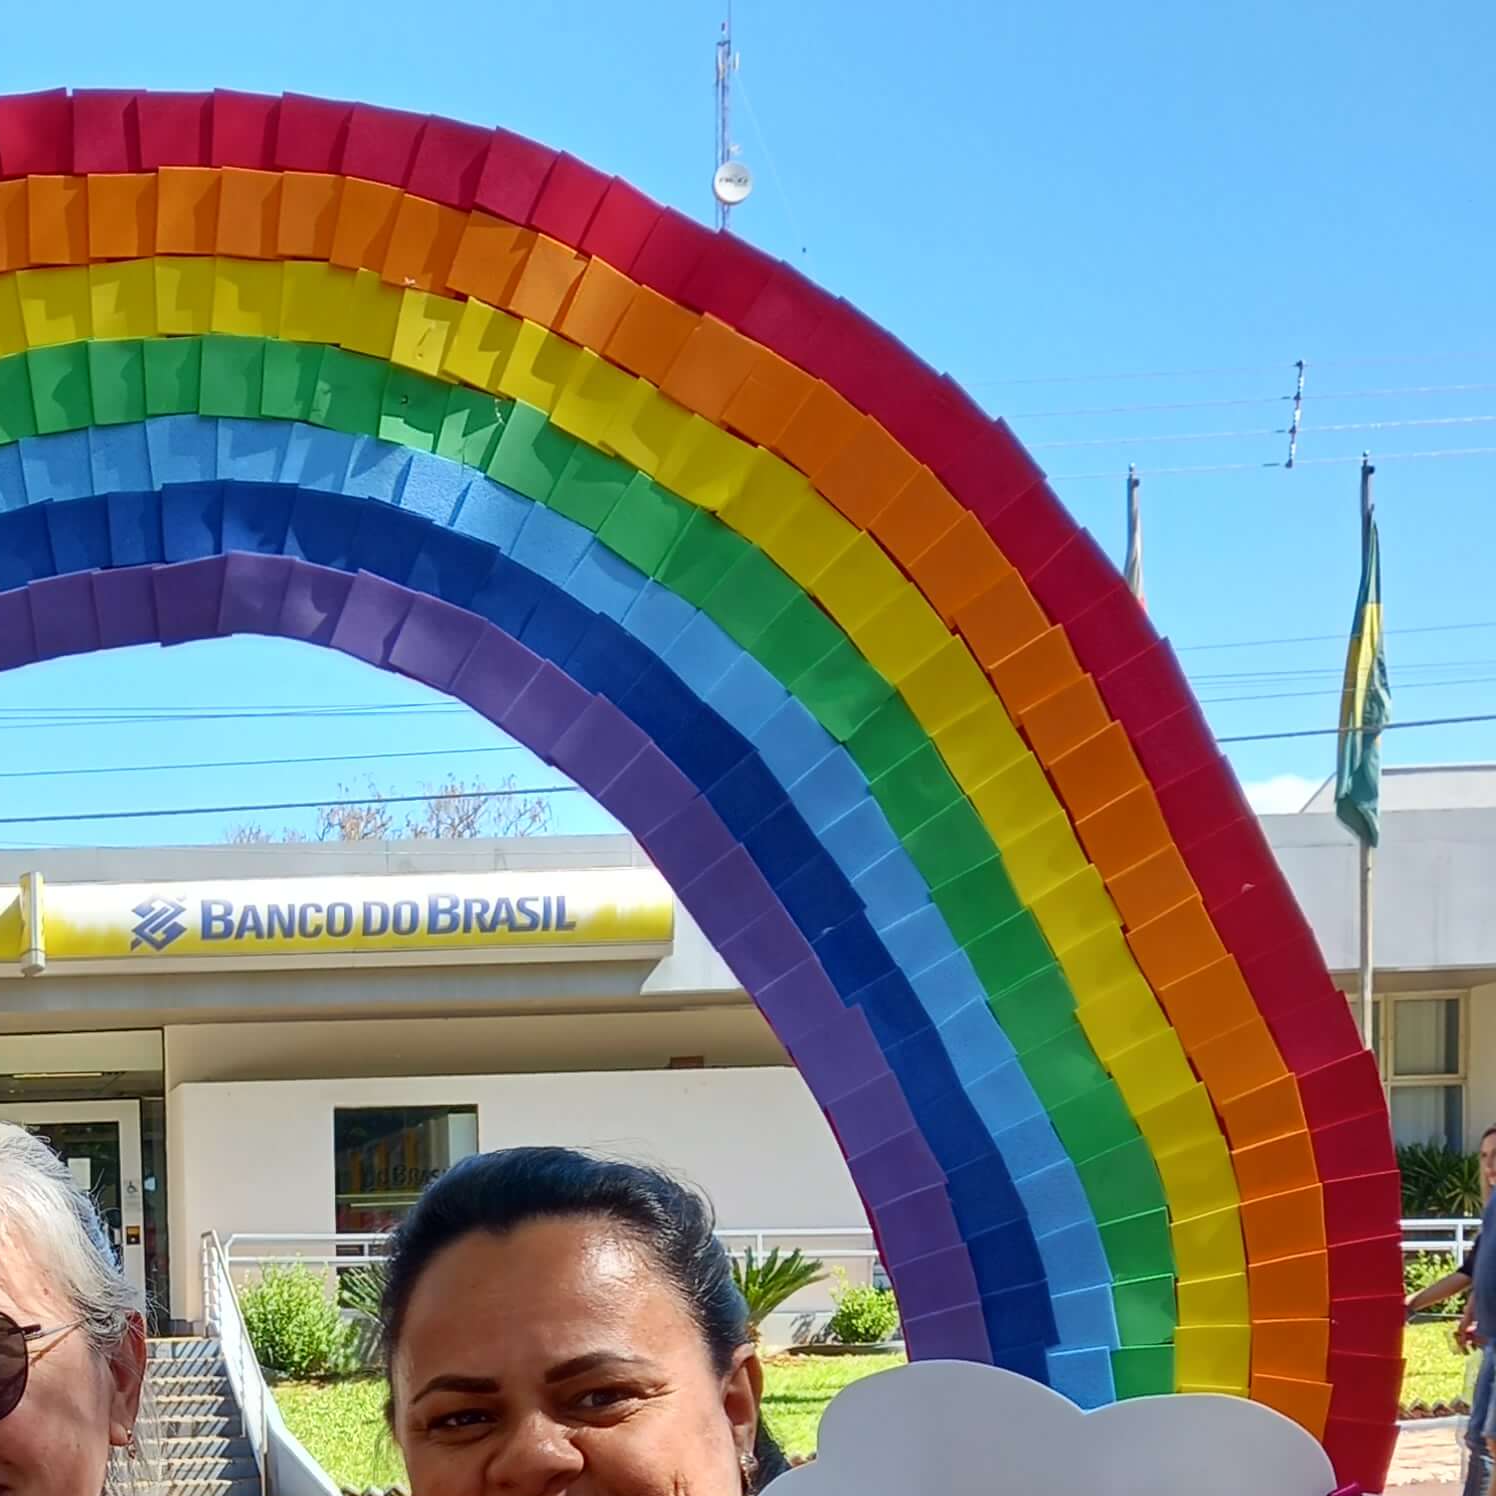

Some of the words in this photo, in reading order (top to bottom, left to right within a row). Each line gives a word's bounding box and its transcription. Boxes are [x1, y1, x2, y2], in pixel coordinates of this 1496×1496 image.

[200, 898, 353, 941] BANCO
[362, 899, 420, 937] DO
[426, 892, 577, 935] BRASIL
